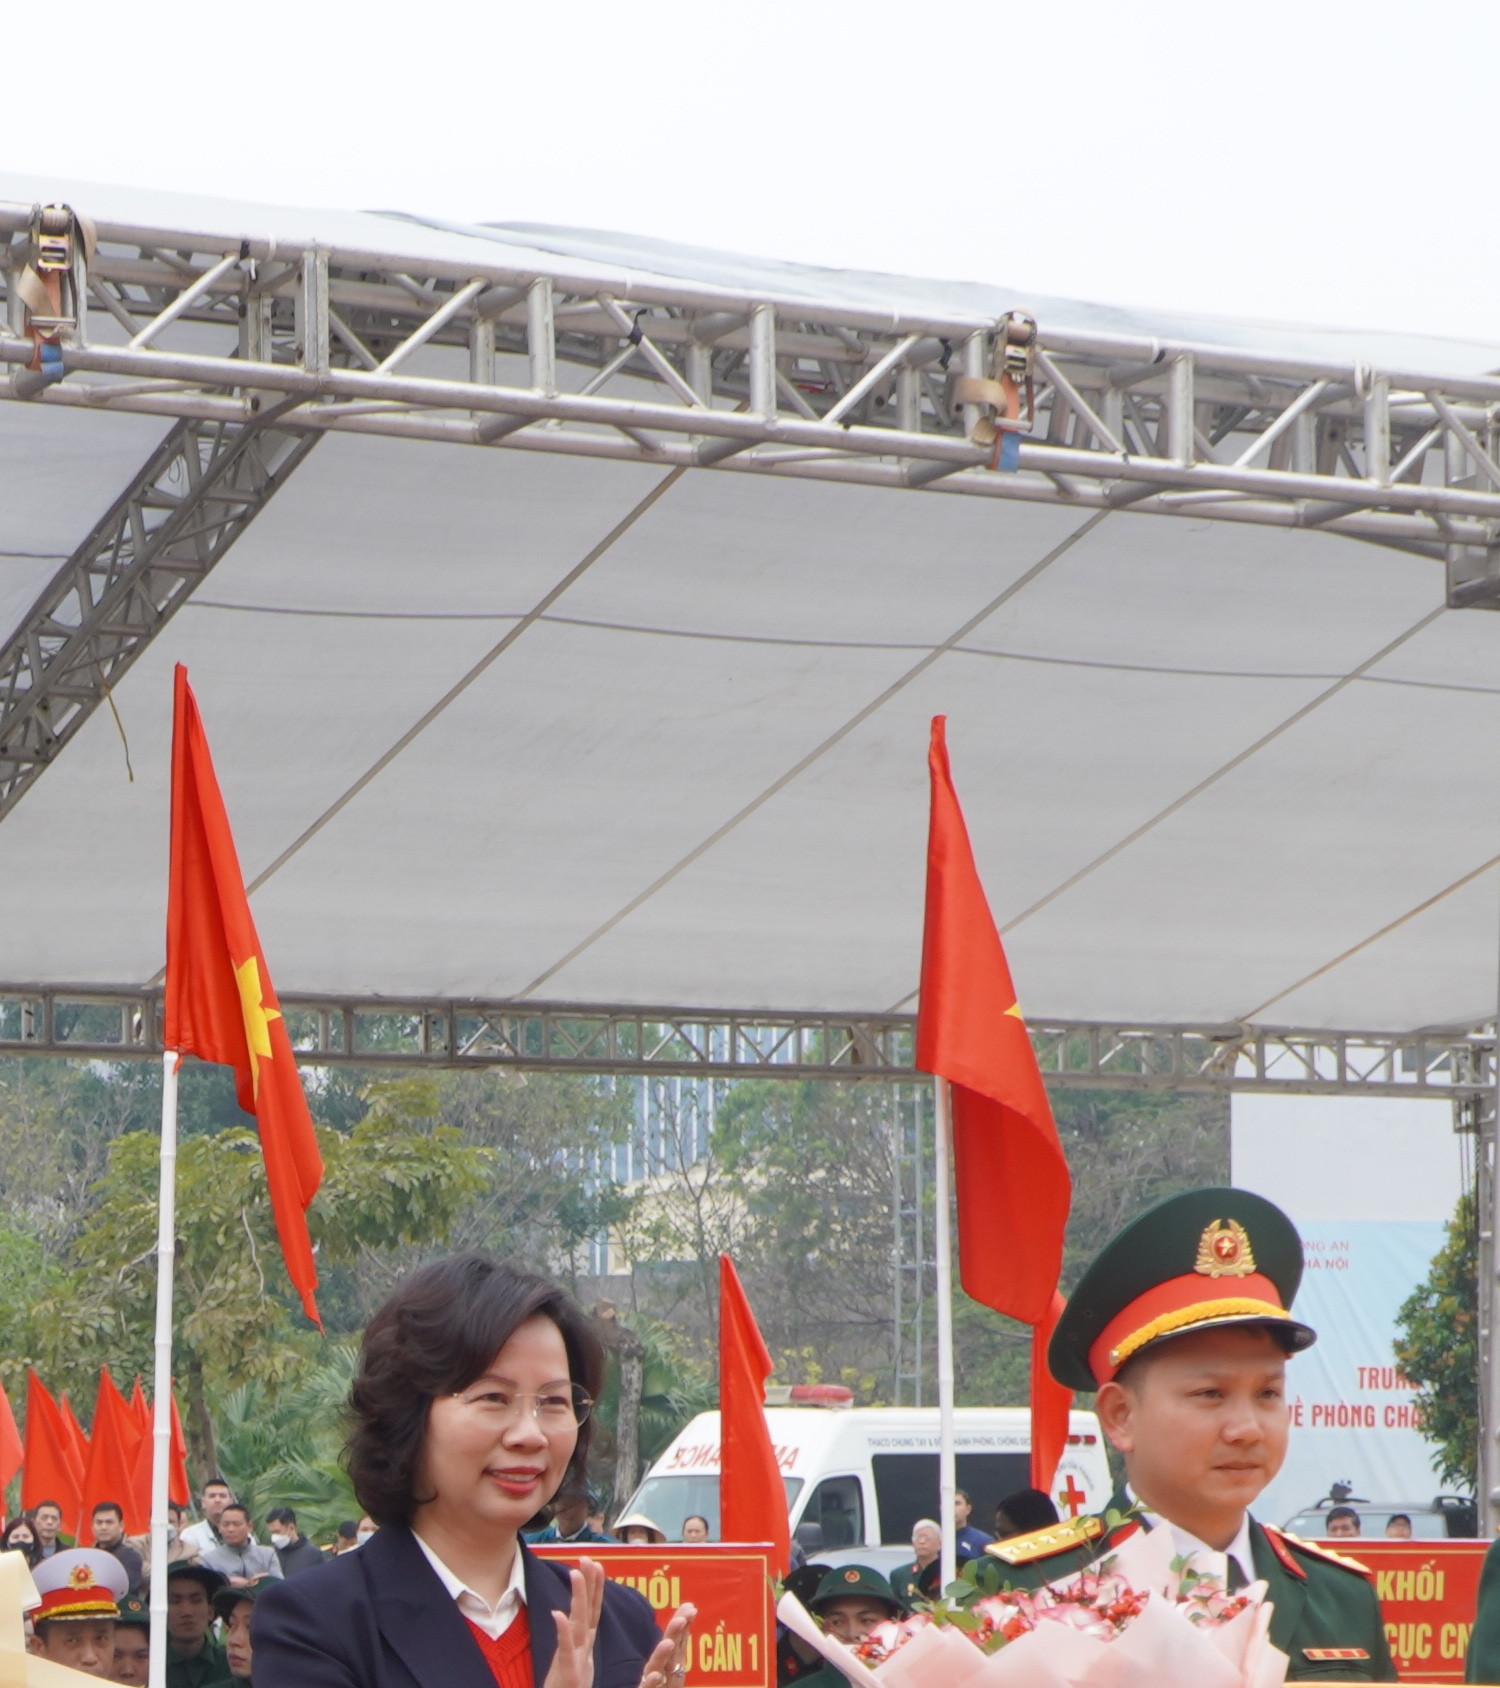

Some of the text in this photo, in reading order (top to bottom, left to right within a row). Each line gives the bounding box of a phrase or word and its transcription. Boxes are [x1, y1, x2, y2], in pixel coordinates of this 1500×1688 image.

[1331, 1241, 1349, 1251] AN
[1326, 1257, 1349, 1270] NỘI
[1312, 1398, 1376, 1428] PHÒNG
[1377, 1559, 1444, 1602] KHỐI
[700, 1620, 742, 1672] CẦN
[748, 1633, 758, 1671] 1
